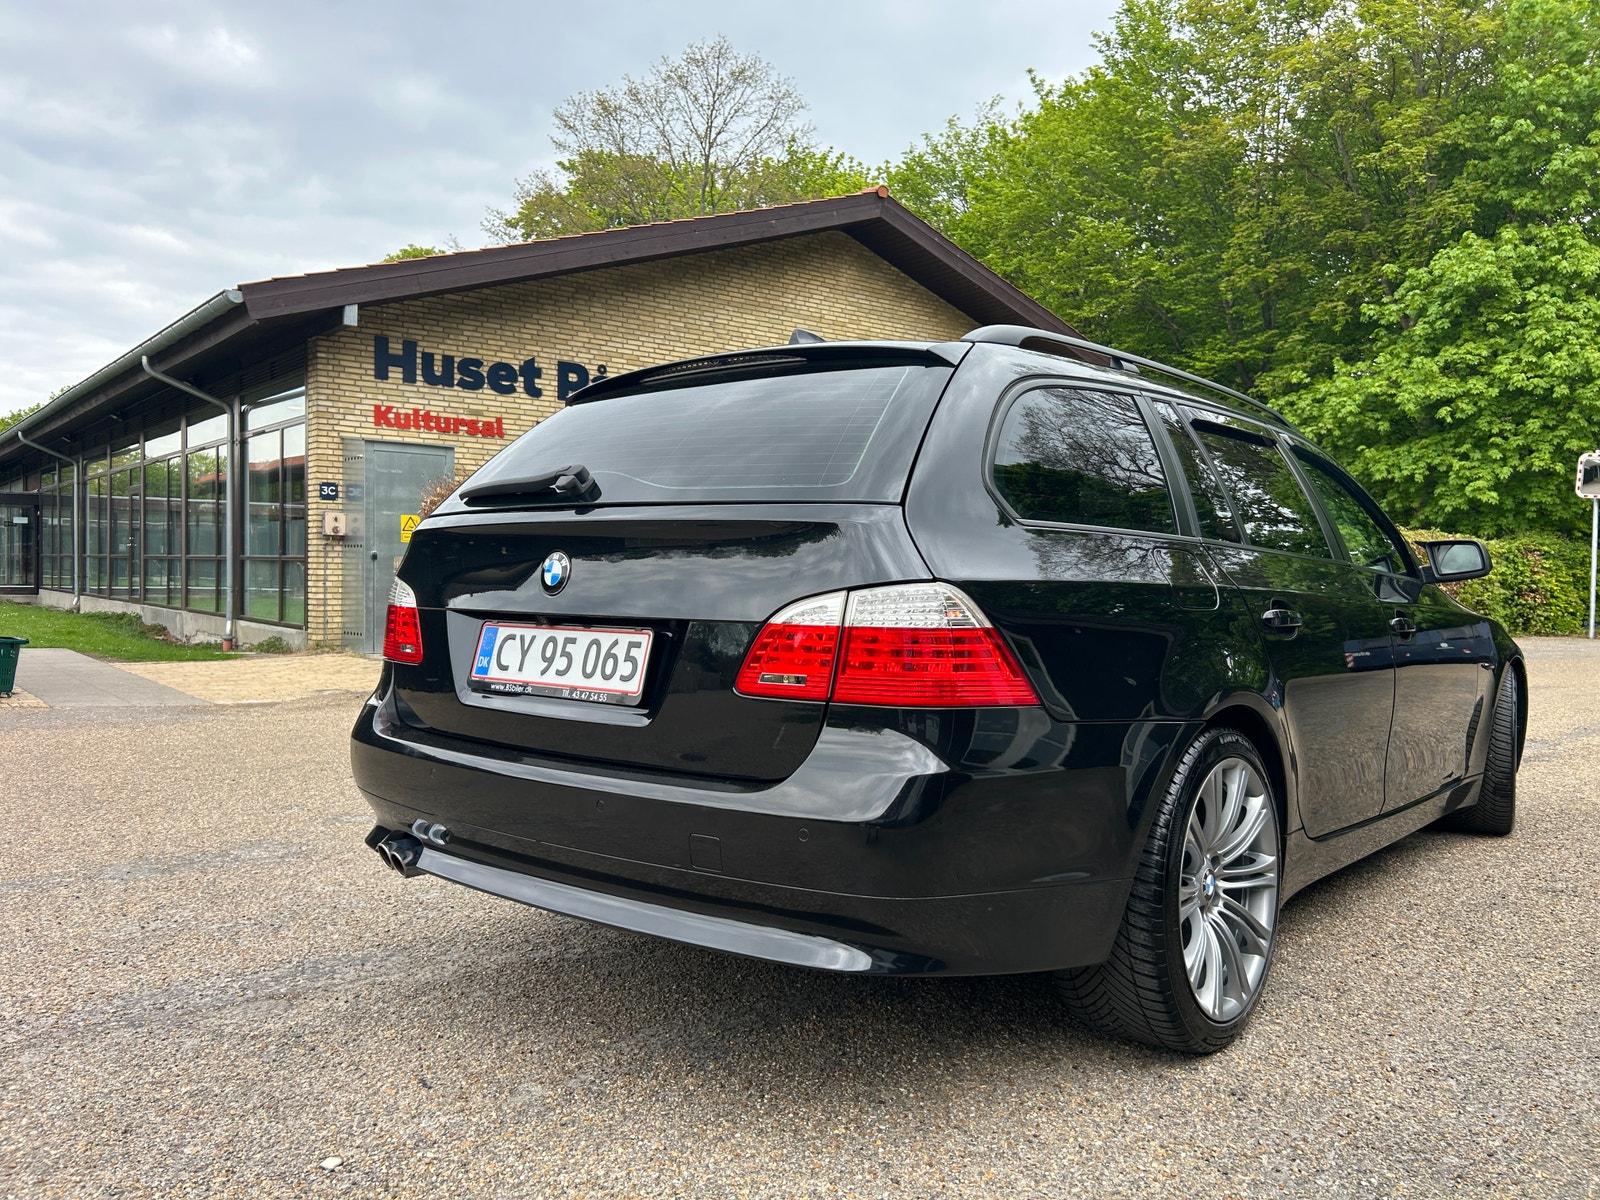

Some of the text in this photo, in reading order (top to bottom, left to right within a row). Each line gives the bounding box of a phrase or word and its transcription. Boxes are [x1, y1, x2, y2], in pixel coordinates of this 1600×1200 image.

[374, 335, 542, 398] Huset
[373, 404, 505, 439] Kultursal
[321, 486, 336, 495] 3C
[477, 656, 489, 668] DK
[496, 634, 642, 682] CY 95 065
[491, 683, 532, 693] www.BSbiler.dk
[572, 691, 581, 699] 43
[599, 694, 608, 702] 55
